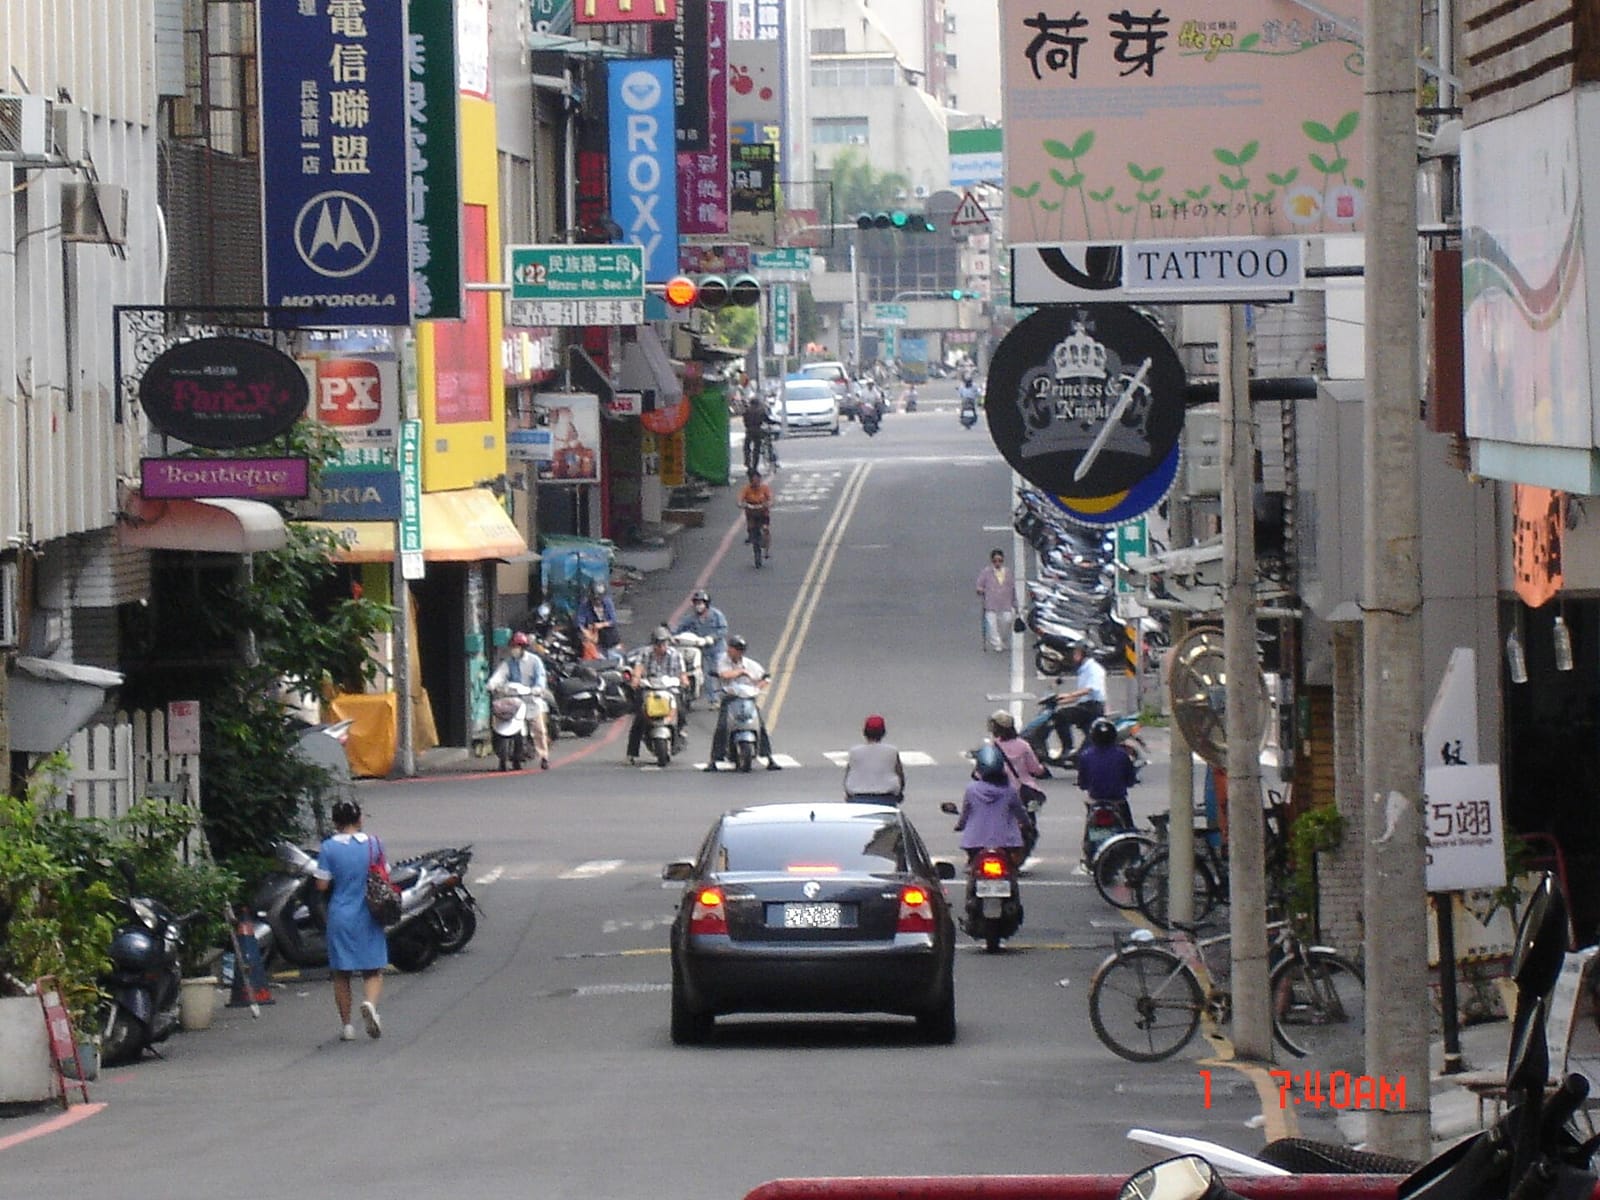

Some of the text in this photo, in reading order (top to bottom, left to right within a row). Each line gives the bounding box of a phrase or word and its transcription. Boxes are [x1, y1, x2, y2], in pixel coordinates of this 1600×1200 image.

[327, 0, 370, 173] 電信聯盟
[300, 80, 320, 174] 民族南一店
[626, 115, 663, 272] ROXY
[525, 263, 546, 283] 22
[549, 255, 631, 273] 民族路二段
[1137, 249, 1288, 280] TATTOO
[281, 294, 396, 307] MOTOROLA
[319, 377, 379, 410] PX
[1032, 377, 1103, 398] Princess
[166, 465, 288, 487] Boutique
